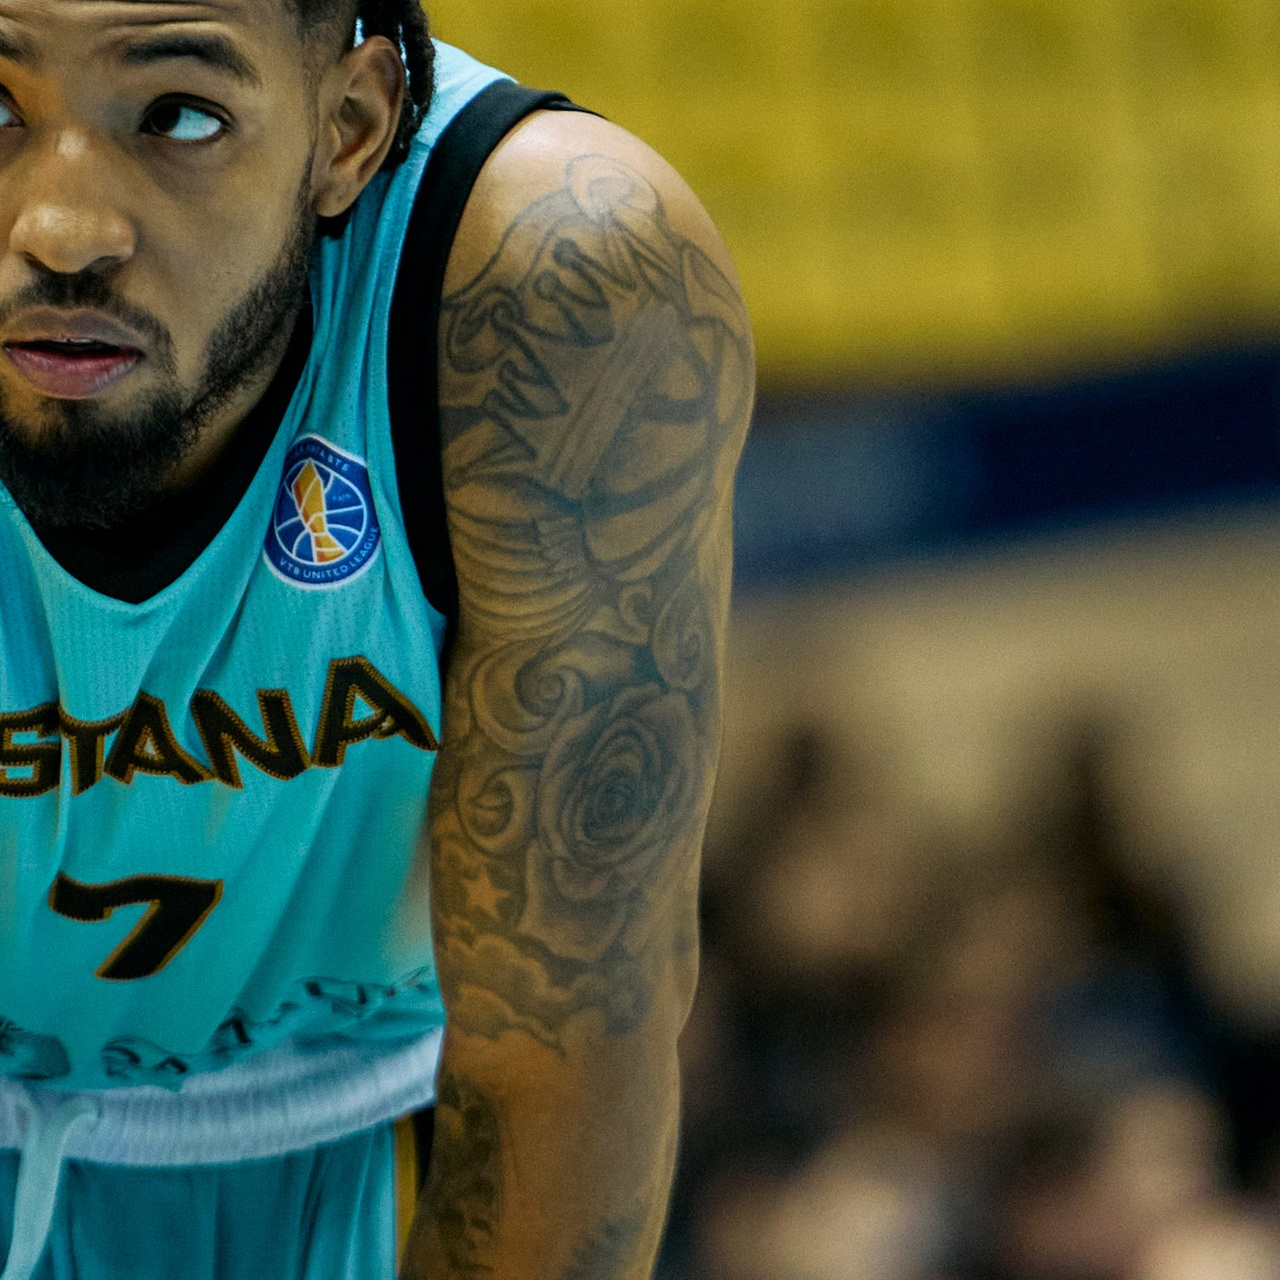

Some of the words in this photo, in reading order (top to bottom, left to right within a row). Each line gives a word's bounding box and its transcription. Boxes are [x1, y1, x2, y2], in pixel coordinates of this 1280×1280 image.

[279, 557, 300, 575] VTB
[302, 564, 348, 579] UNITED
[47, 870, 224, 982] 7
